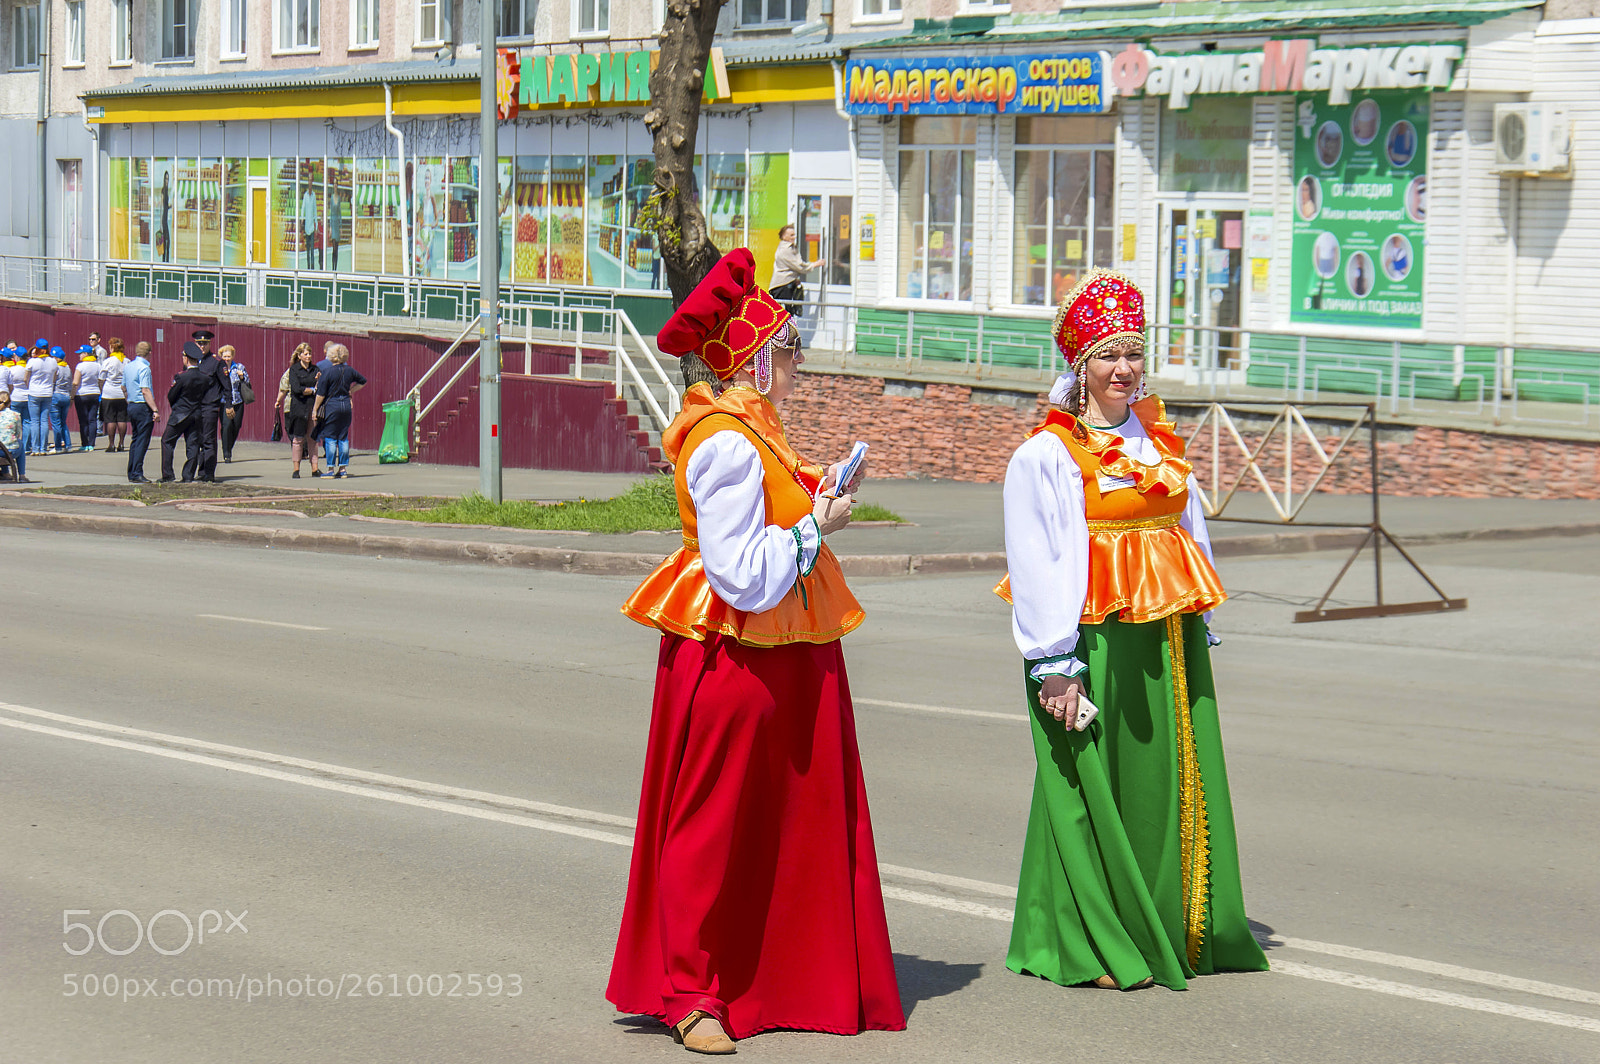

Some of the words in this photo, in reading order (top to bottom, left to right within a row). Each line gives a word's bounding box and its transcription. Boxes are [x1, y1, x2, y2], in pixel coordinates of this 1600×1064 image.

[519, 47, 729, 105] МАРИЯ
[850, 65, 1017, 113] Мадагаскар
[1029, 57, 1092, 81] остров
[1022, 82, 1100, 113] игрушек
[1112, 39, 1462, 109] ФармаМаркет
